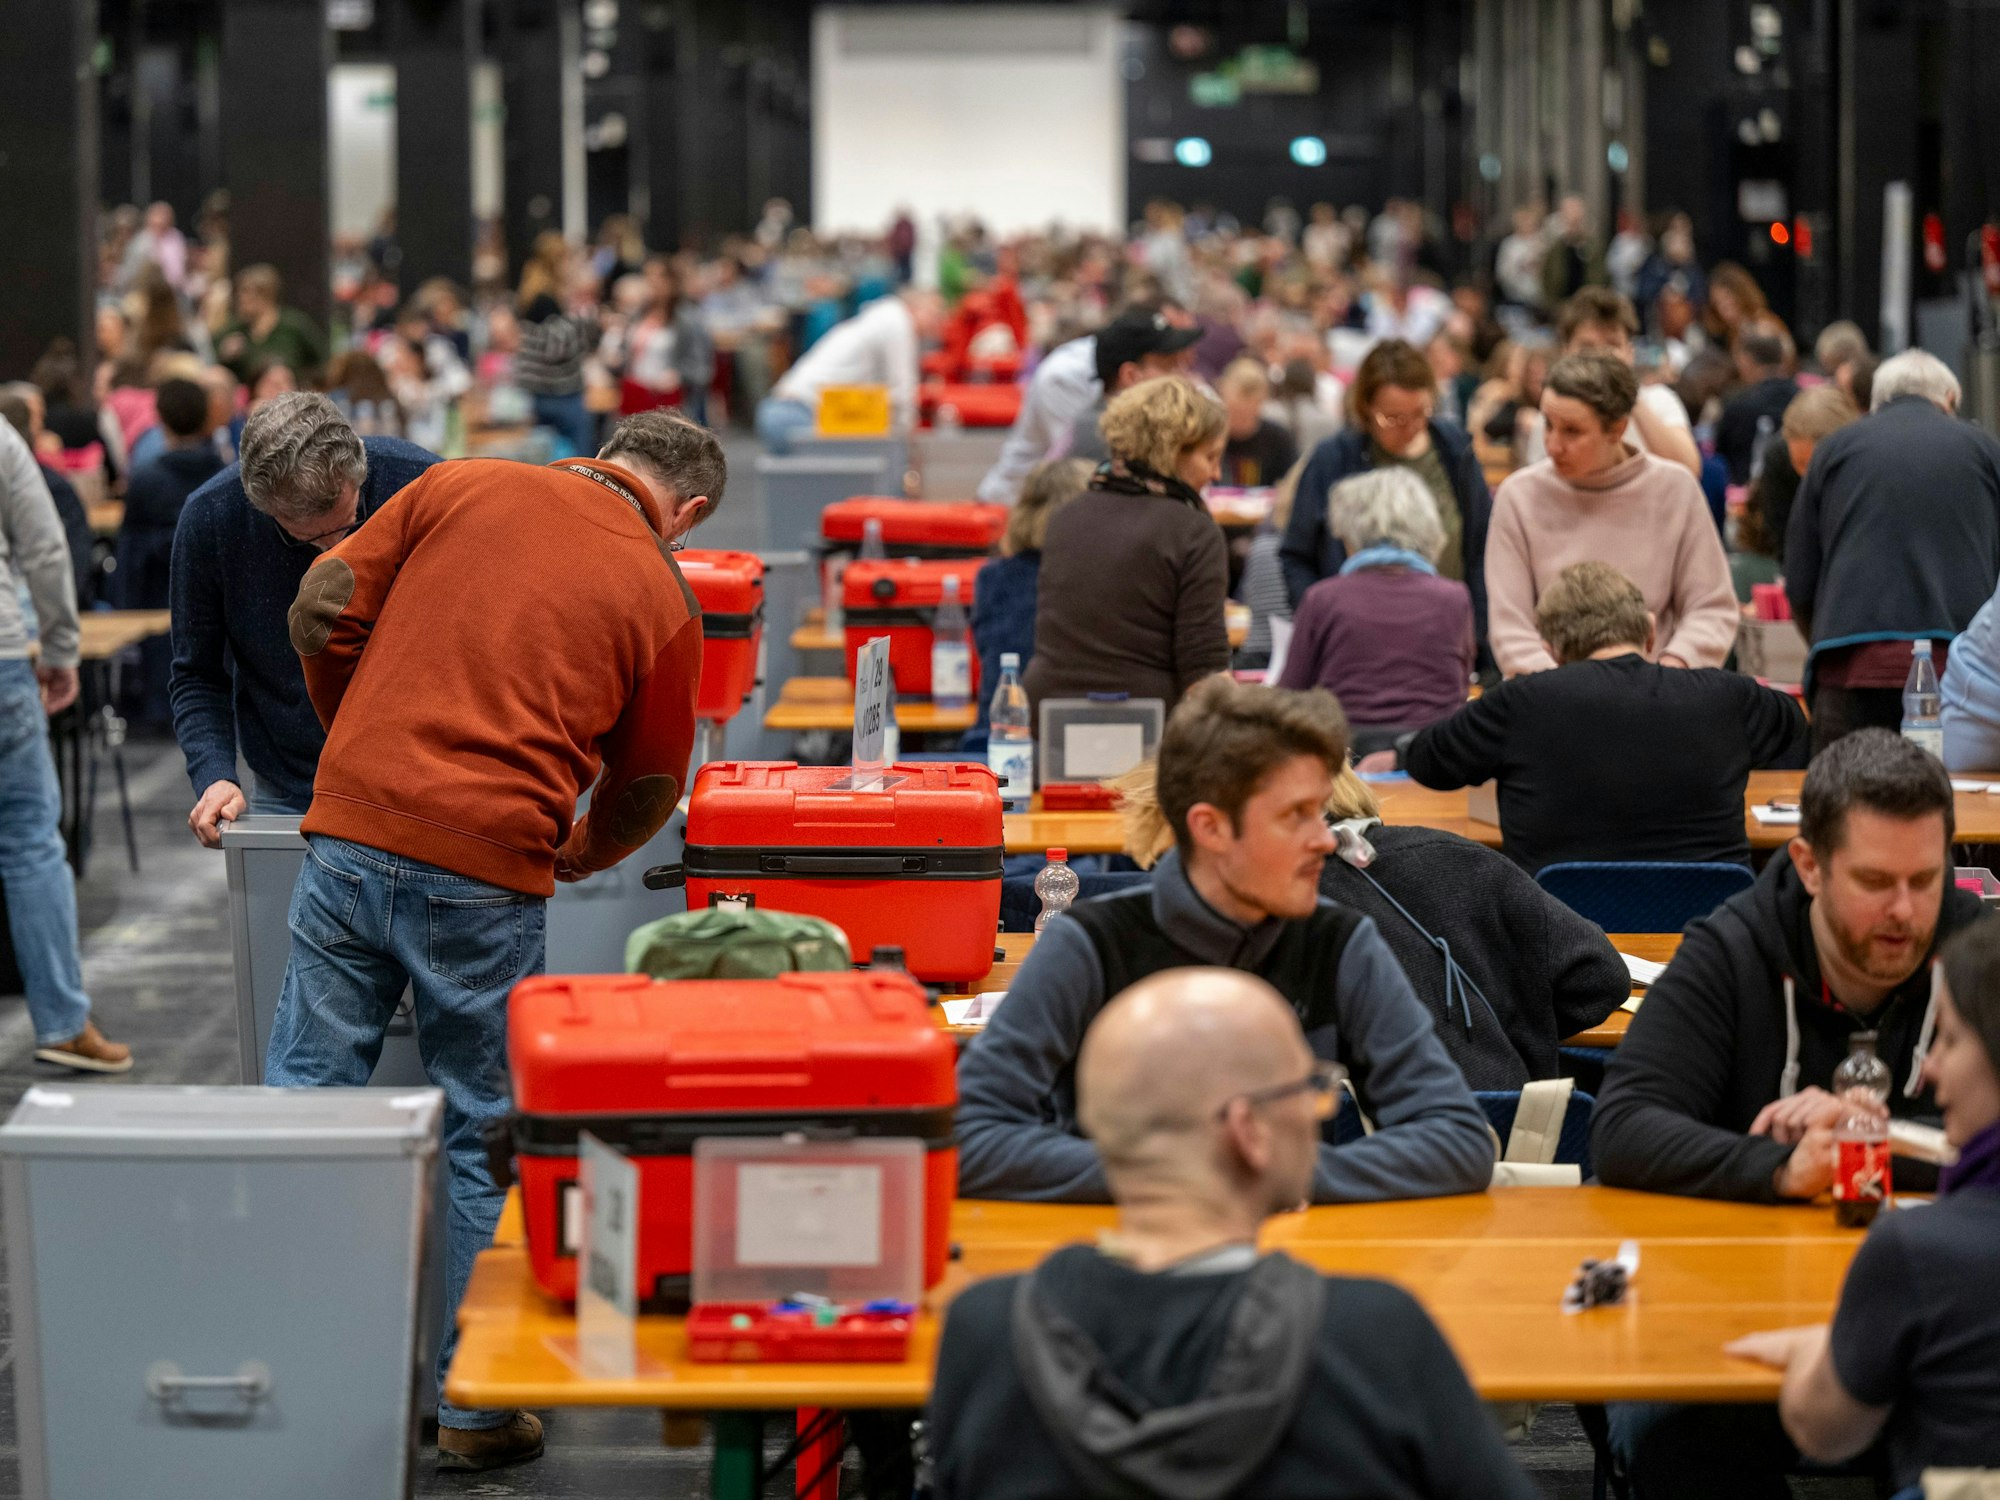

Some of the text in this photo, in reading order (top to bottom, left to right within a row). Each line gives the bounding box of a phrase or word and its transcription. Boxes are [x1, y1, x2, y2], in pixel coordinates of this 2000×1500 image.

[569, 464, 642, 510] SPIRIT OF THE NORTH
[874, 657, 882, 687] 29
